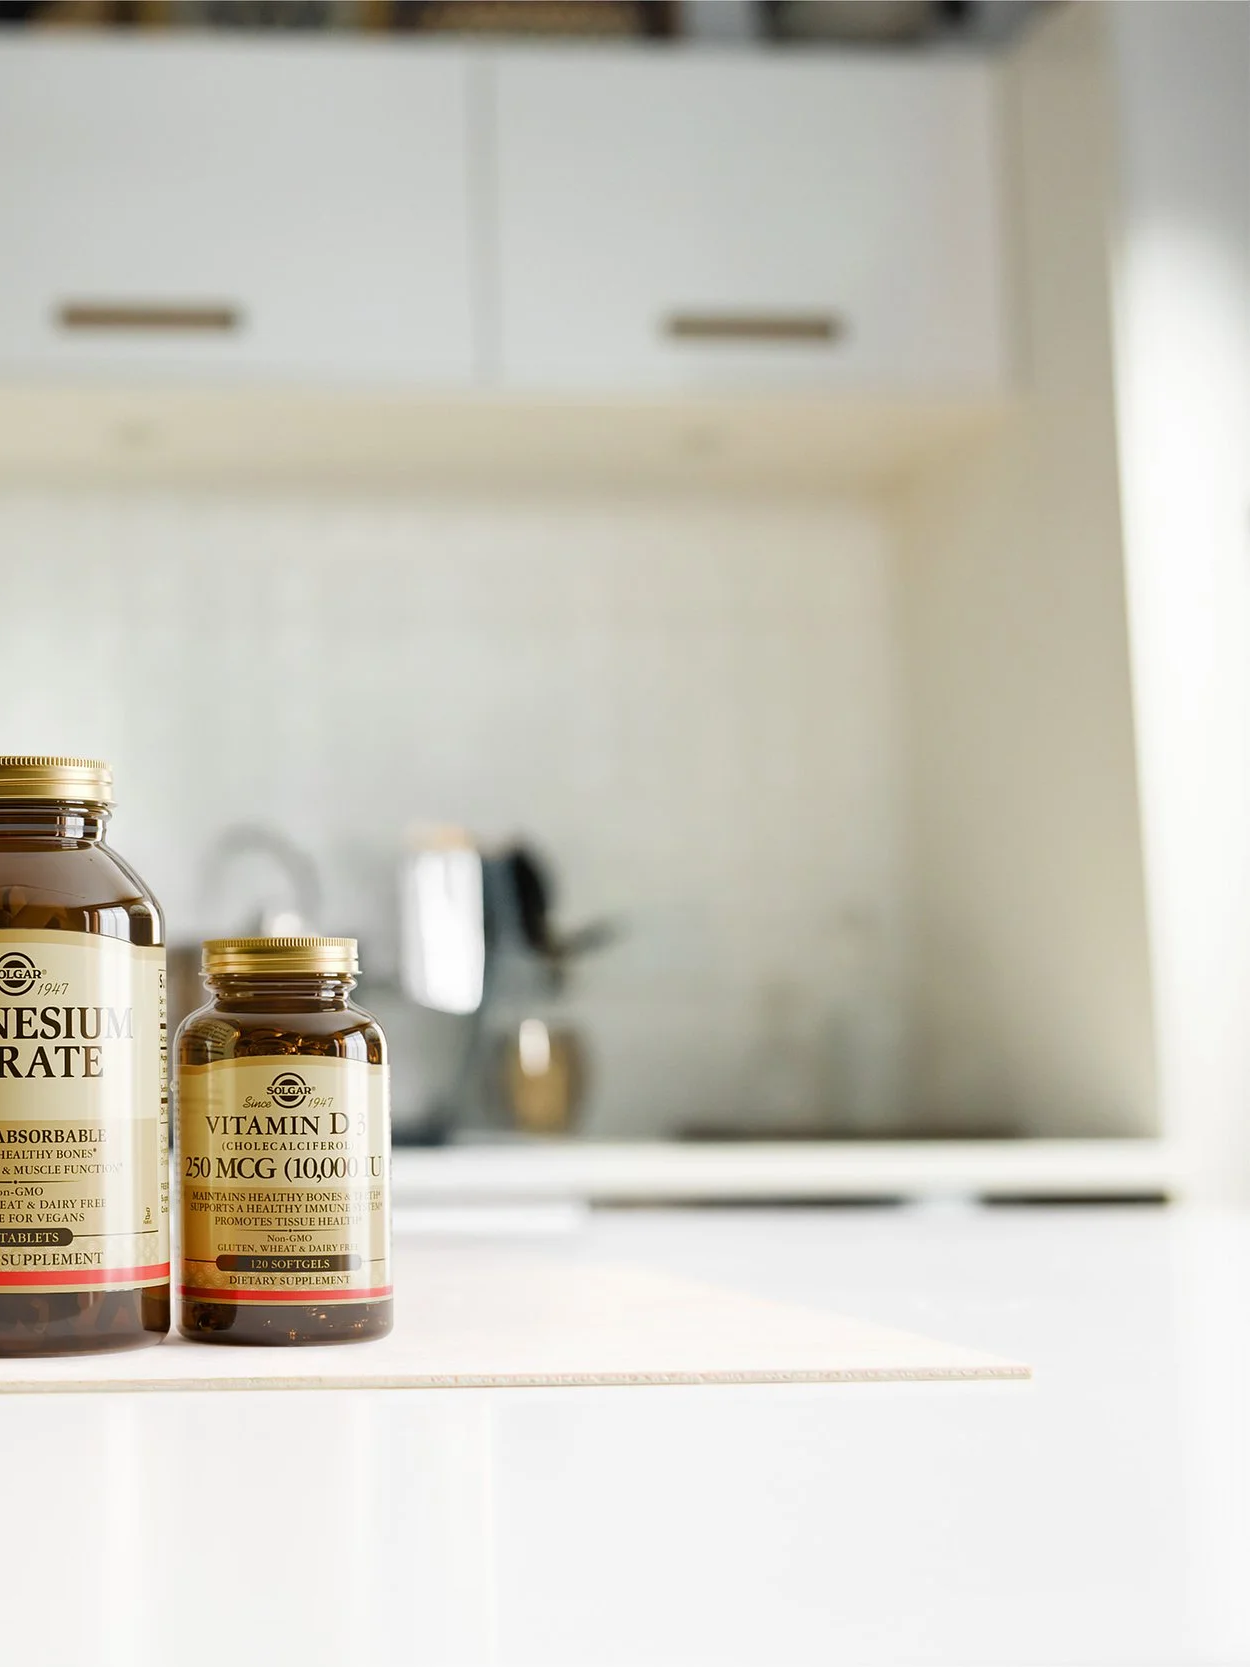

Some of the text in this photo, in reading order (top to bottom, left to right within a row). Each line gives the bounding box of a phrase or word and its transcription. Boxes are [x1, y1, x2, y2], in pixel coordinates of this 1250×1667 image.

[37, 982, 69, 996] 1947
[243, 1096, 333, 1108] Since 1947
[205, 1116, 320, 1136] VITAMIN
[14, 1165, 61, 1175] MUSCLE
[186, 1156, 211, 1178] 250
[216, 1157, 277, 1179] MCG
[284, 1157, 358, 1183] (10,000
[192, 1192, 246, 1200] MAINTAINS
[249, 1193, 305, 1202] HEALTHY
[308, 1192, 342, 1201] BONES
[27, 1200, 35, 1209] &
[39, 1200, 77, 1210] DAIRY
[80, 1199, 107, 1208] FREE
[190, 1204, 234, 1213] SUPPORTS
[237, 1204, 244, 1213] A
[247, 1204, 302, 1214] HEALTHY
[305, 1204, 350, 1212] IMMUNE
[8, 1213, 33, 1222] FOR
[36, 1212, 85, 1222] VEGANS
[215, 1217, 272, 1226] PROMOTES
[276, 1217, 315, 1226] TISSUE
[0, 1232, 59, 1243] TABLETS
[217, 1245, 257, 1253] GLUTEN,
[1, 1252, 104, 1266] SUPPLEMENT
[251, 1260, 330, 1269] 120 SOFTGELS
[230, 1276, 350, 1286] DIETARY SUPPLEMENT
